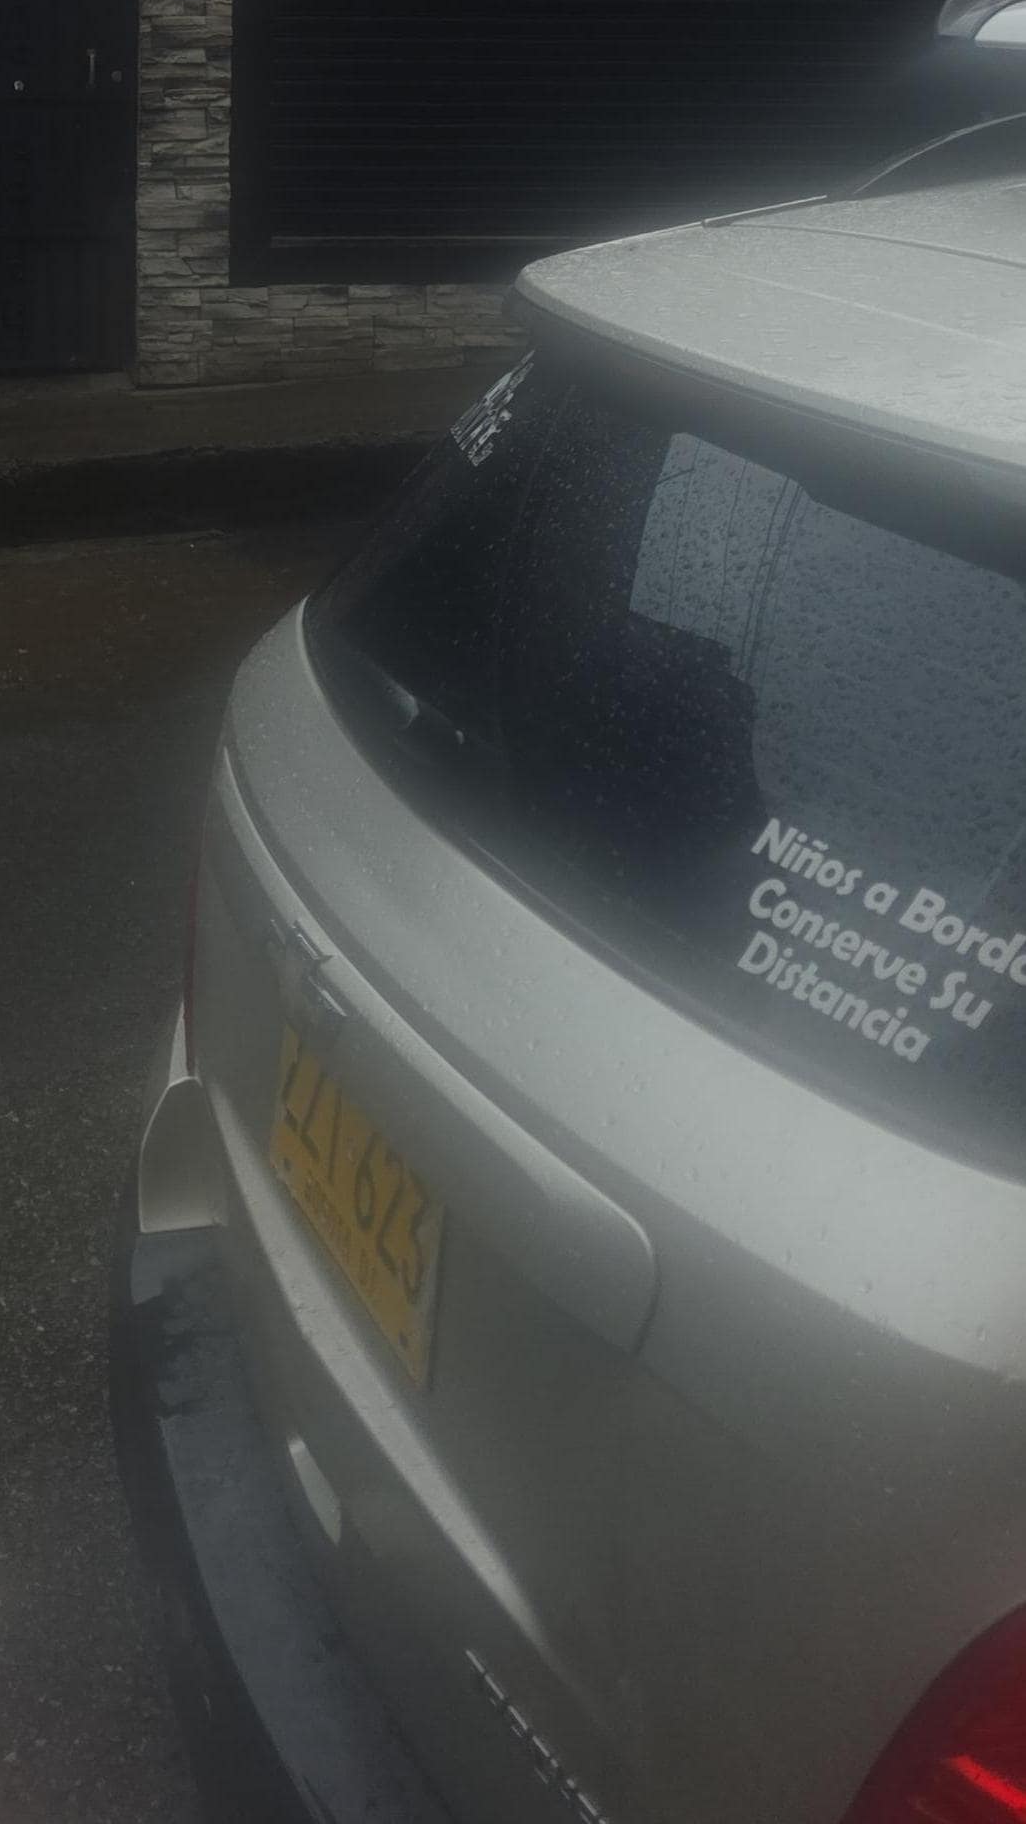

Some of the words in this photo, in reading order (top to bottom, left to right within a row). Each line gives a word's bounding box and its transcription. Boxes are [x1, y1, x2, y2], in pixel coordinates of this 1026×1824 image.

[750, 817, 864, 896] Niños
[863, 881, 900, 916] a
[737, 930, 932, 1063] Distancia
[748, 878, 927, 995] Conserve
[929, 971, 993, 1031] Su
